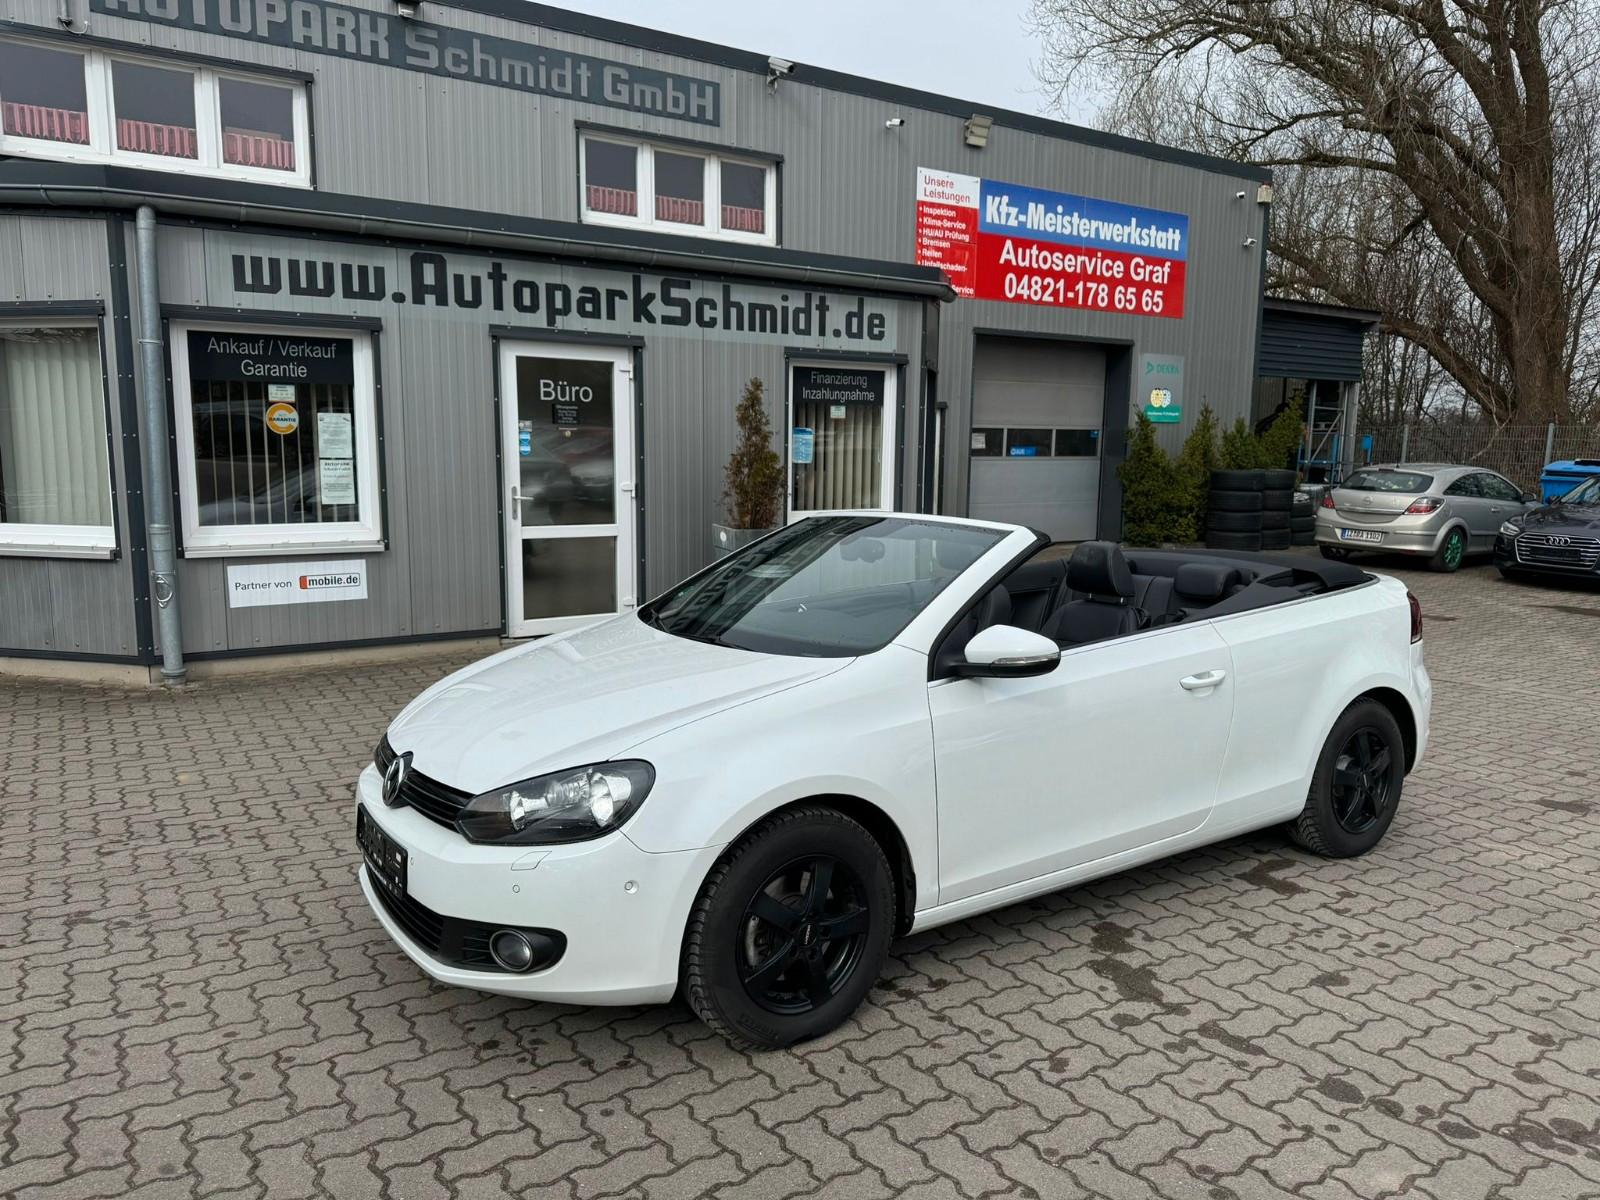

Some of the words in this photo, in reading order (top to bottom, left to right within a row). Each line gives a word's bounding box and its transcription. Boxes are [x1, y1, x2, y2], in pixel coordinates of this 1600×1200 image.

[404, 25, 591, 97] Schmidt
[602, 65, 714, 121] GmbH
[924, 175, 954, 189] Unsere
[923, 187, 970, 204] Leistungen
[923, 205, 956, 218] Inspektion
[923, 216, 966, 230] Klima-Service
[985, 194, 1181, 252] Kfz-Meisterwerkstatt
[922, 238, 951, 249] Bremsen
[945, 229, 969, 243] Prüfung
[999, 239, 1125, 279] Autoservice
[1130, 256, 1171, 285] Graf
[232, 252, 886, 341] www.AutoparkSchmidt.de
[1004, 272, 1109, 308] 04821-178
[1114, 285, 1136, 311] 65
[1141, 288, 1164, 313] 65
[207, 336, 265, 356] Ankauf
[277, 340, 337, 359] Verkauf
[241, 359, 308, 378] Garantie
[810, 371, 868, 388] Finanzierung
[539, 379, 593, 402] Büro
[802, 386, 875, 403] Inzahlungnahme
[234, 581, 271, 591] Partner
[274, 580, 292, 589] von
[308, 575, 359, 587] mobile.de
